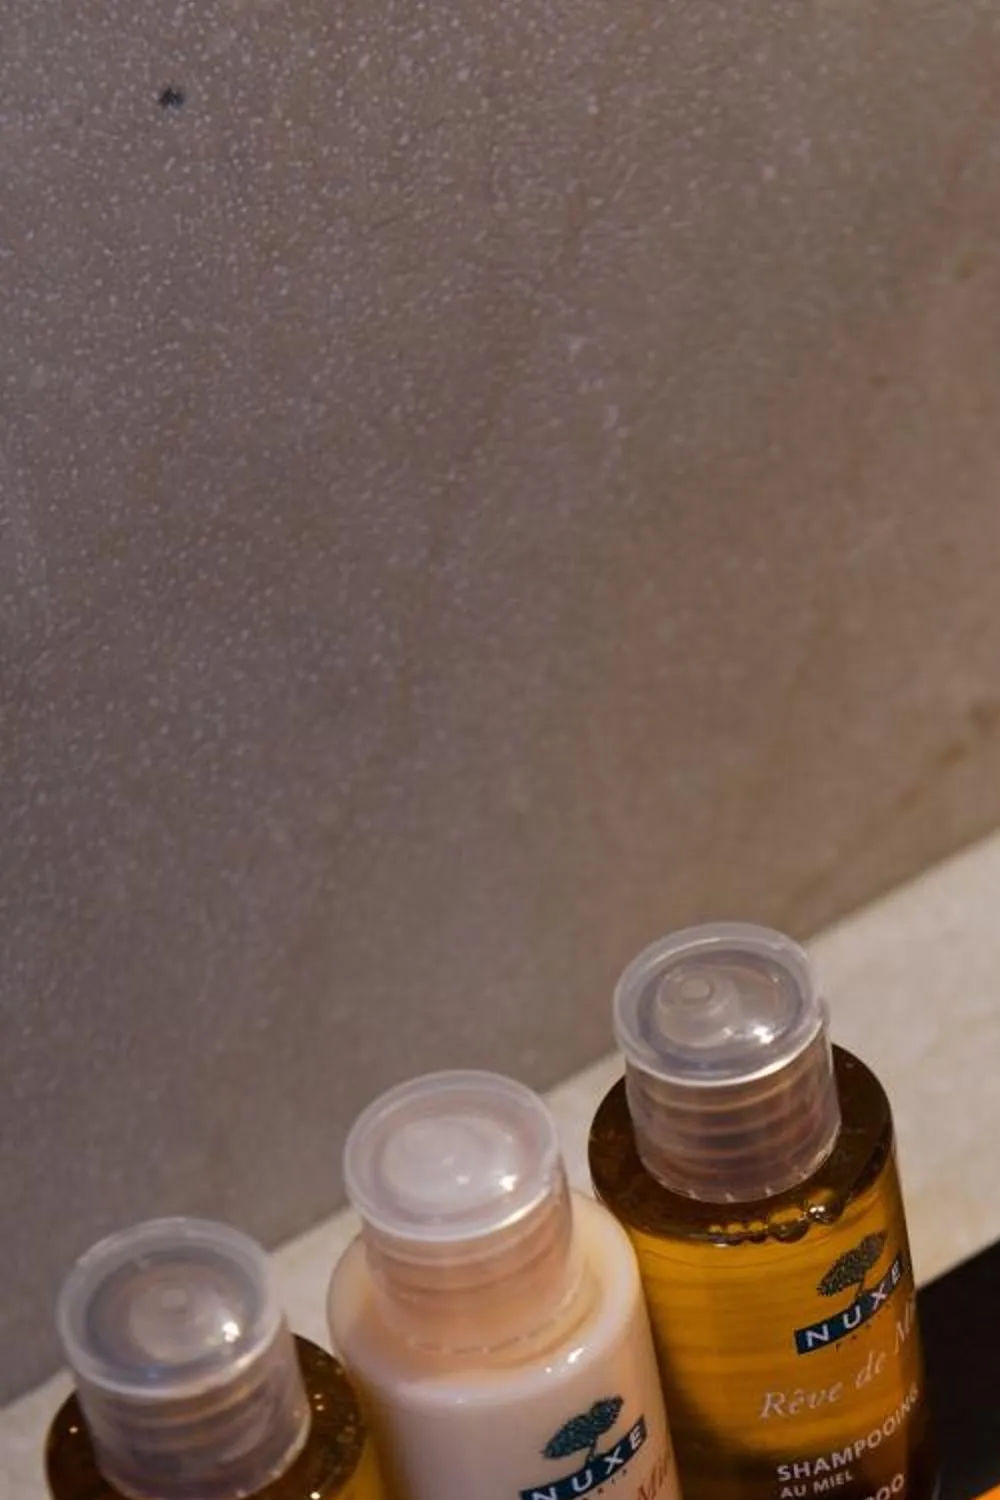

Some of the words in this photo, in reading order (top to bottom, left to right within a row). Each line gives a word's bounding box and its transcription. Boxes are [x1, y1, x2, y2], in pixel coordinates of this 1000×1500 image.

[805, 1260, 900, 1348] NUXE
[760, 1382, 843, 1420] Rêve
[855, 1350, 886, 1390] de
[776, 1382, 920, 1482] SHAMPOOING
[780, 1483, 807, 1500] AU
[812, 1469, 855, 1495] MIEL
